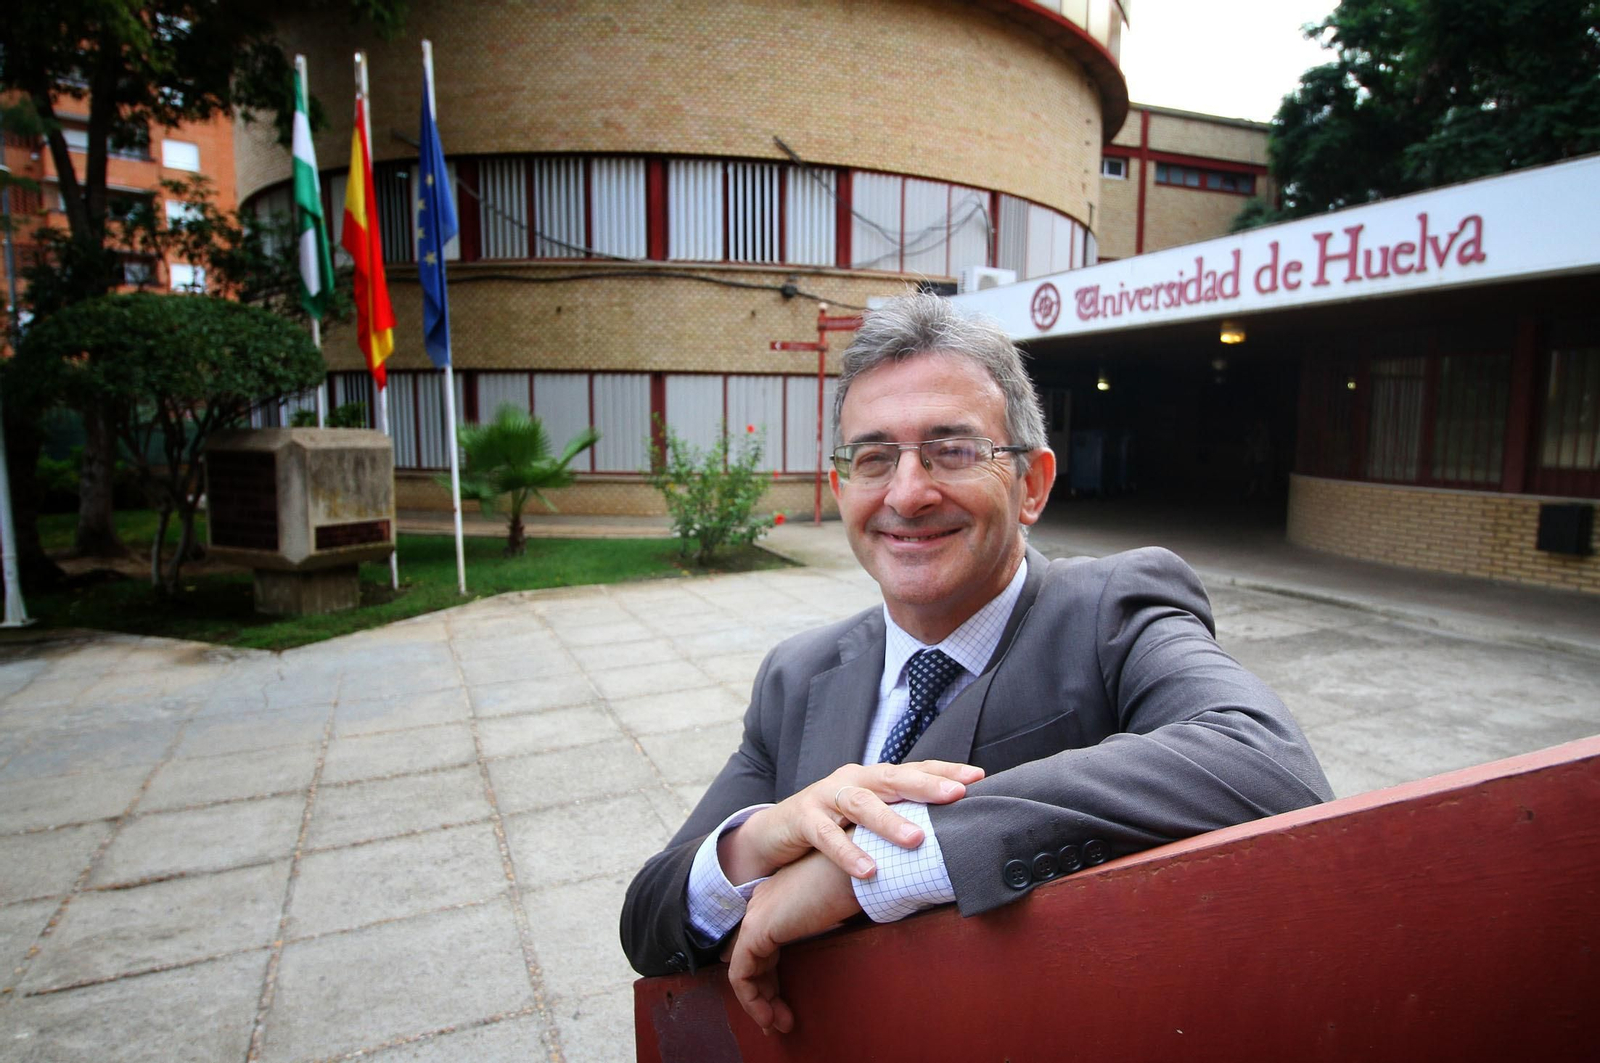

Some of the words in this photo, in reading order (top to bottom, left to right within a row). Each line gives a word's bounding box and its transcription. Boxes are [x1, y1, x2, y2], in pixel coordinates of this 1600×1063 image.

[1075, 248, 1241, 321] Universidad
[1254, 241, 1302, 293] de
[1312, 213, 1486, 286] Huelva
